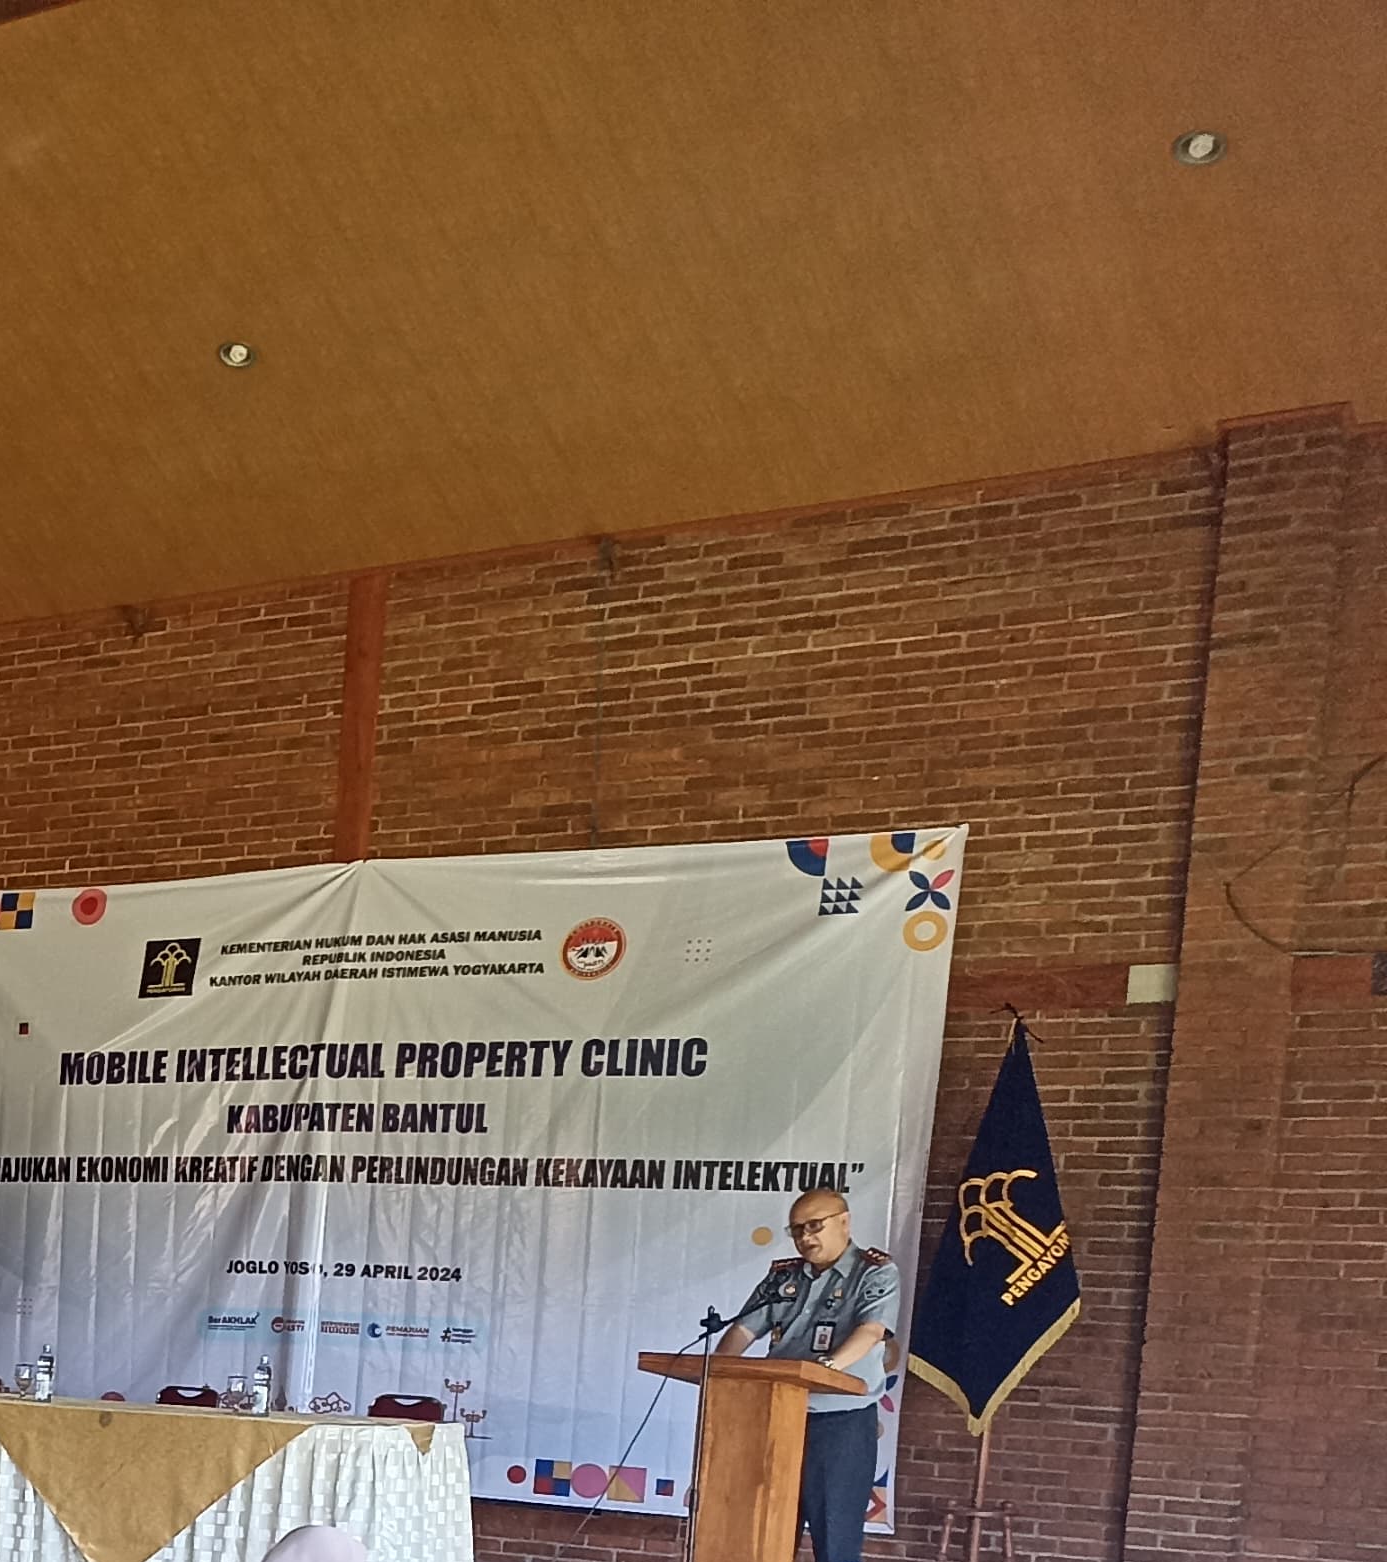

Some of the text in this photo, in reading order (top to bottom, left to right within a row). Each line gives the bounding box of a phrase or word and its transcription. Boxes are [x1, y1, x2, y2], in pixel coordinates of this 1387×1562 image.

[221, 930, 542, 955] KEMENTERIAN HUKUM DAN HAK ASASI MANUSIA
[302, 949, 446, 966] REPUBLIK INDONESIA
[209, 963, 544, 987] KANTOR WILAYAH DAERAH ISTIMEWA YOGYAKARTA
[59, 1038, 708, 1086] MOBILE INTELLECTUAL PROPERTY CLINIC
[227, 1103, 488, 1134] KABUPATEN BANTUL
[76, 1156, 169, 1183] EKONOMI
[174, 1155, 259, 1184] KREATIF
[260, 1154, 345, 1183] DENGAN
[351, 1155, 529, 1187] PERLINDUNGAN
[535, 1158, 666, 1189] KEKAYAAN
[227, 1260, 279, 1275] JOGLO
[333, 1263, 356, 1277] 29
[360, 1264, 414, 1280] APRIL
[417, 1266, 463, 1282] 2024
